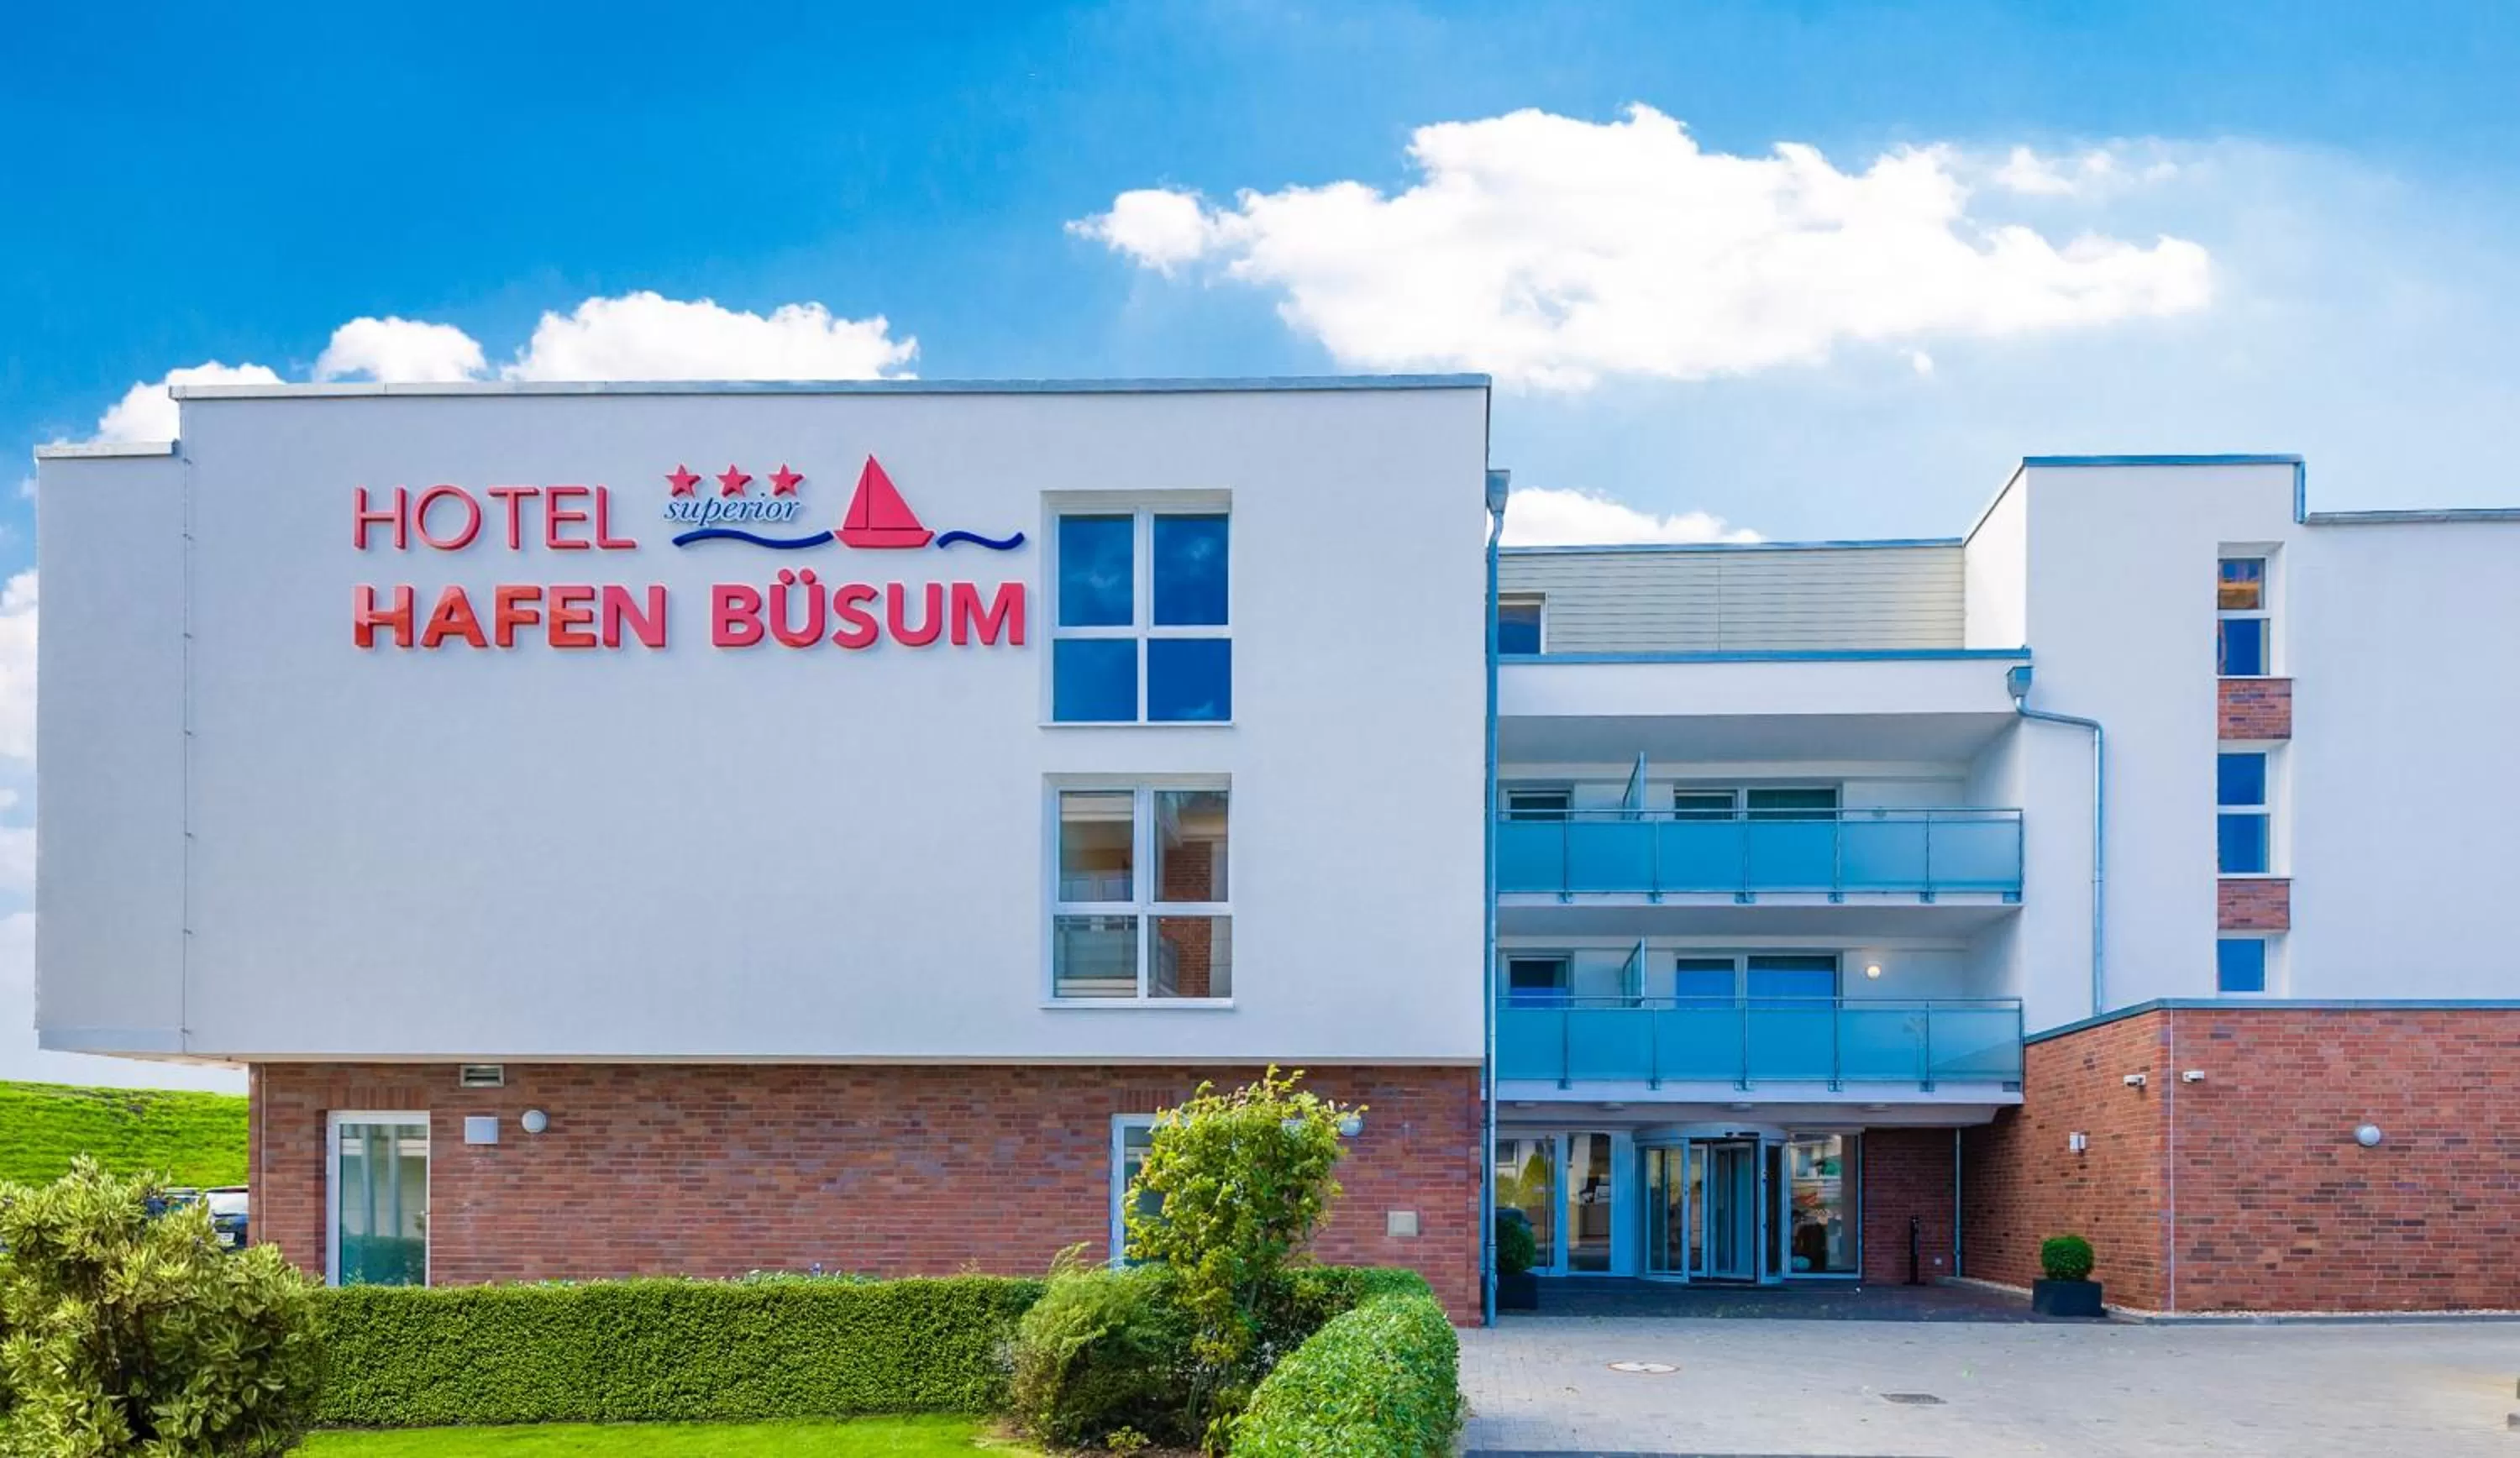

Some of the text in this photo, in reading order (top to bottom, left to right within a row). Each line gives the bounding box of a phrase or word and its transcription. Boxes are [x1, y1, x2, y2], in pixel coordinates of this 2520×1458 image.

[354, 485, 637, 551] HOTEL
[663, 492, 801, 527] superior
[354, 568, 1026, 649] HAFEN BÜSUM
